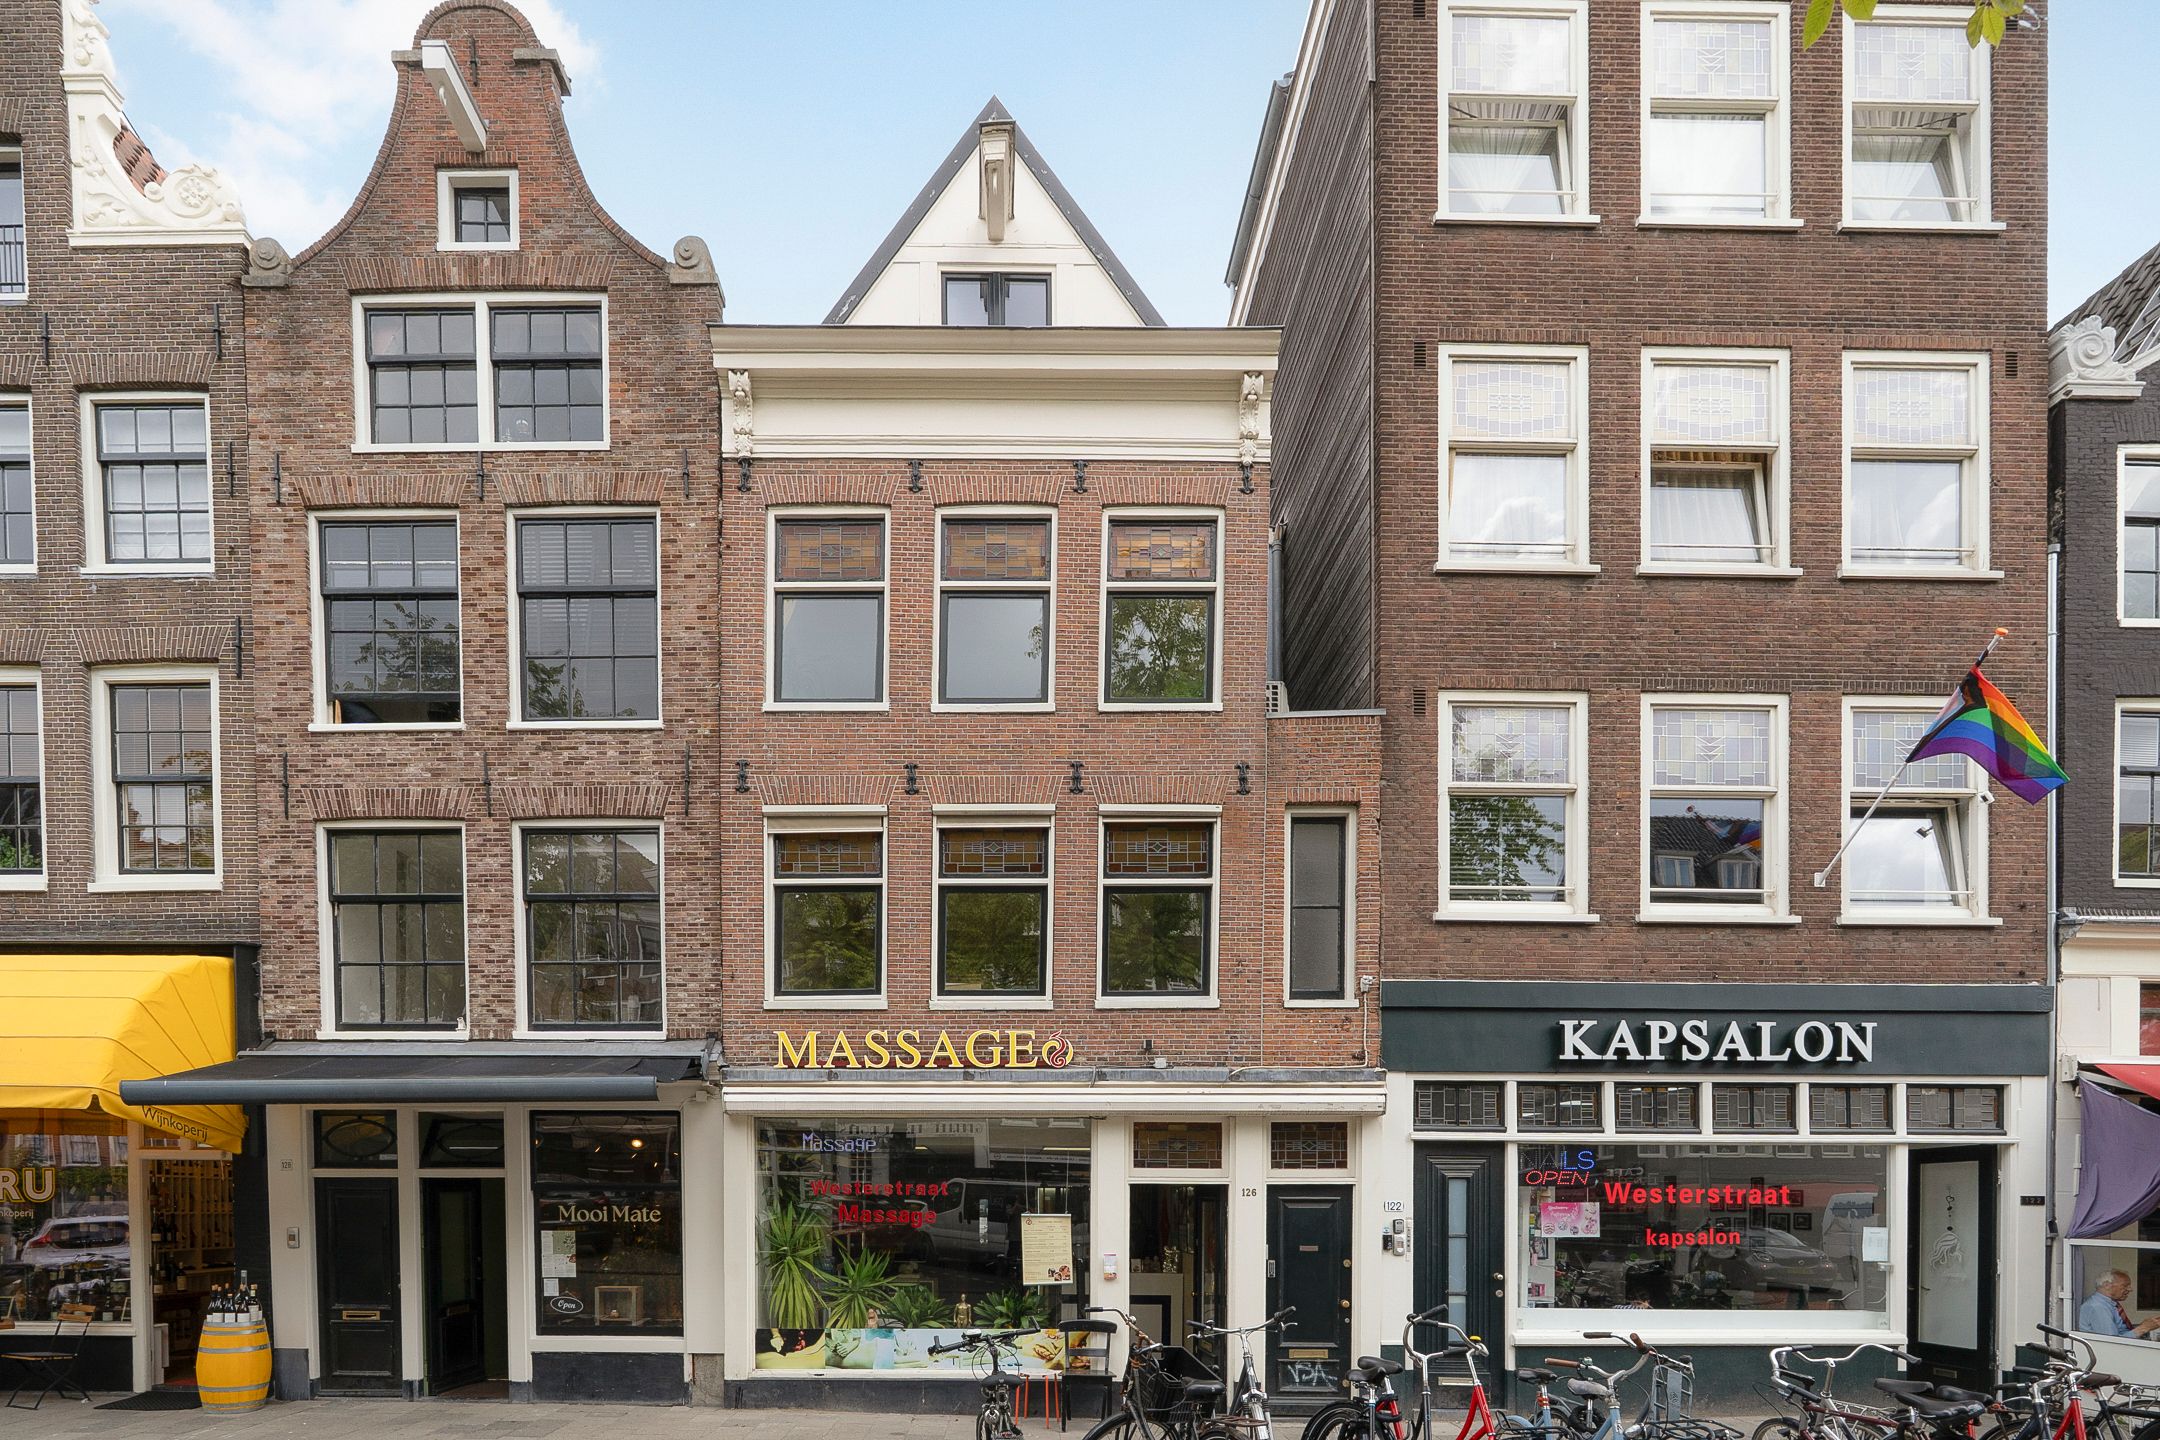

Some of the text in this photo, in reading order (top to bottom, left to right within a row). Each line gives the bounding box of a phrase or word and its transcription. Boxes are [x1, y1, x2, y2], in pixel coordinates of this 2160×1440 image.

[773, 1029, 1038, 1069] MASSAGE
[1558, 1019, 1877, 1062] KAPSALON
[142, 1105, 209, 1142] Wijnkoperij
[802, 1132, 877, 1153] Massage
[1520, 1150, 1595, 1170] NAILS
[1526, 1170, 1590, 1185] OPEN
[810, 1180, 948, 1197] Westerstraat
[1241, 1188, 1257, 1197] 126
[1604, 1181, 1790, 1205] Westerstraat
[558, 1205, 662, 1222] Mooi Mate
[838, 1205, 937, 1228] Massage
[1387, 1202, 1402, 1211] 122
[1646, 1228, 1741, 1248] kapsalon
[558, 1300, 576, 1309] Open
